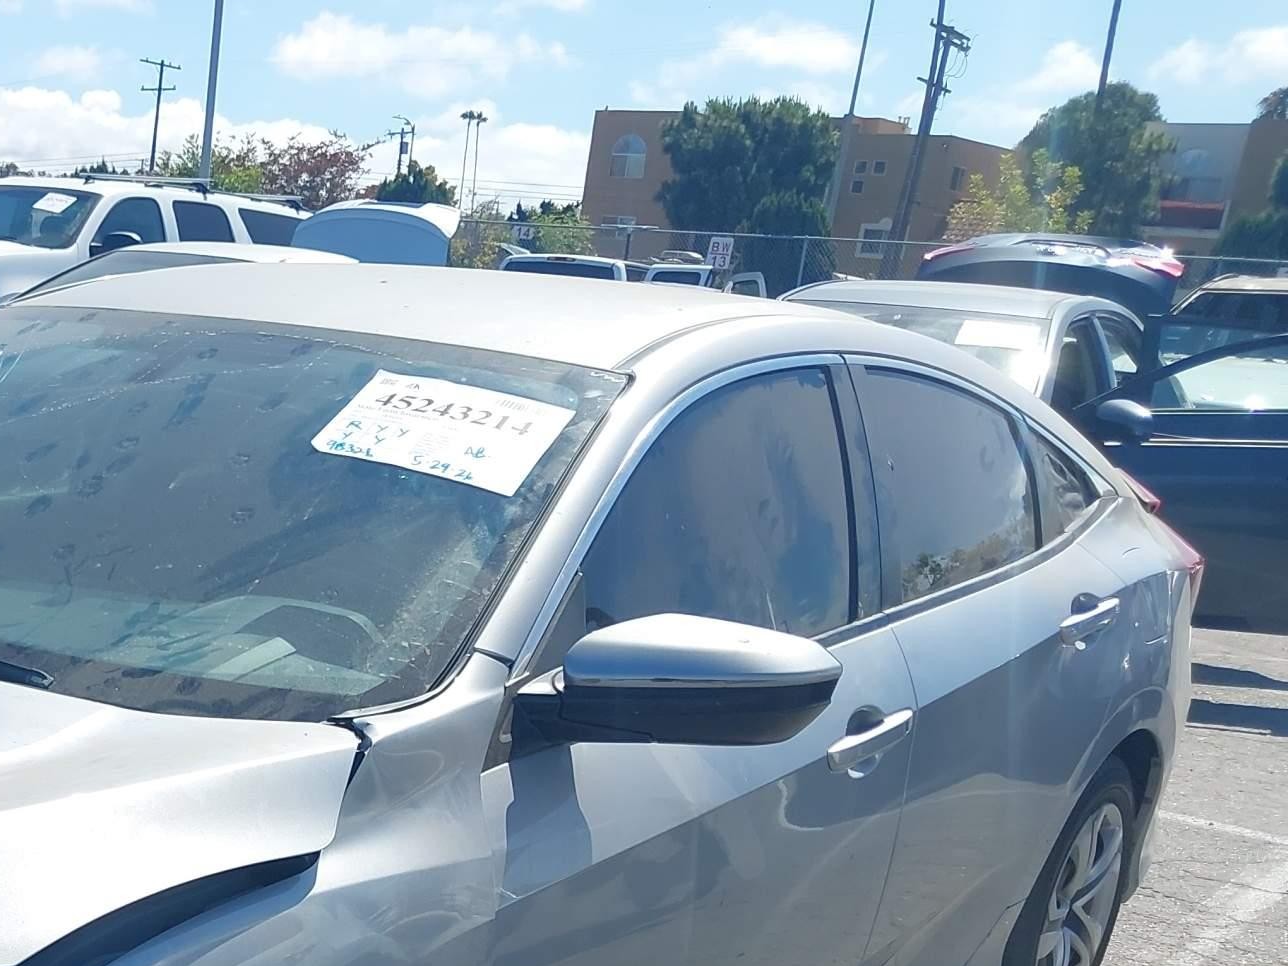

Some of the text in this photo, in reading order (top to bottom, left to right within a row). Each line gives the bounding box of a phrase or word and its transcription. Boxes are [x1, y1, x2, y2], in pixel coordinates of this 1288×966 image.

[712, 242, 731, 252] BW
[712, 255, 726, 267] 13
[375, 393, 533, 435] 45243214
